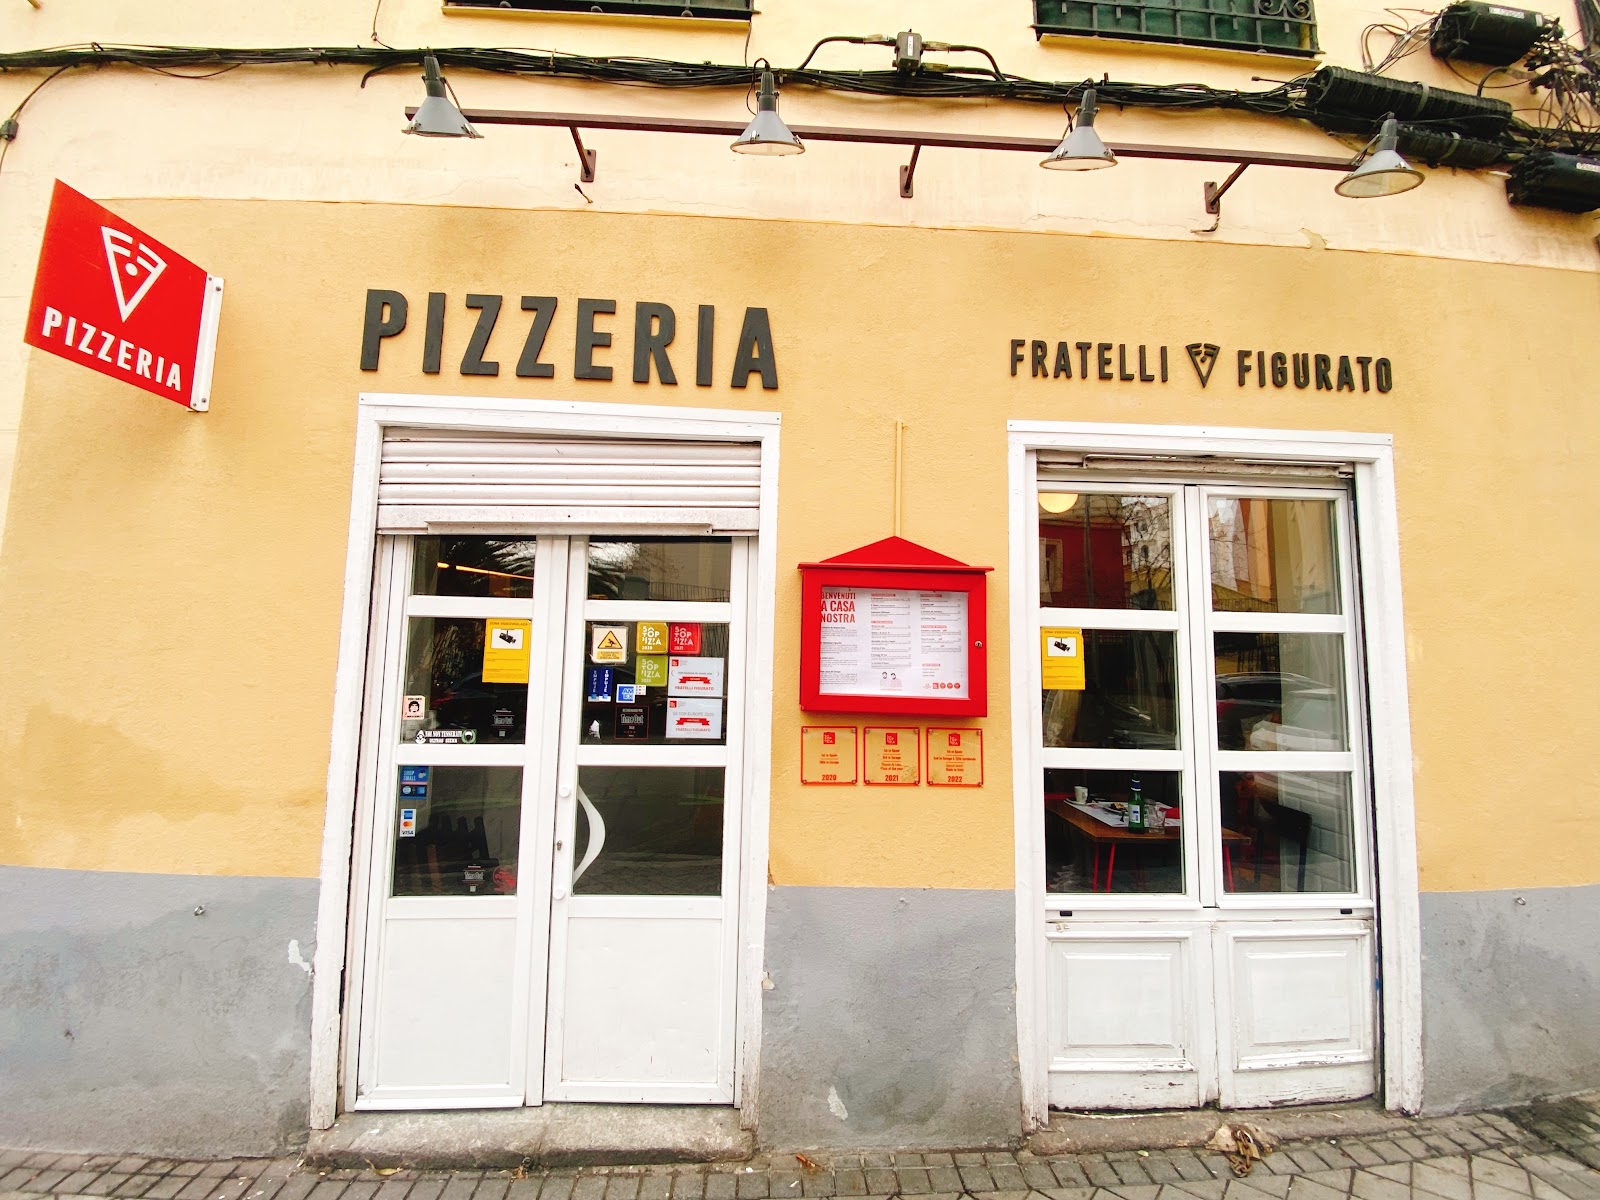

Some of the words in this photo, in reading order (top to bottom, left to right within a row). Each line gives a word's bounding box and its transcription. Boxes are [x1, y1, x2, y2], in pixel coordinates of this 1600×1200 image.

[360, 289, 778, 389] PIZZERIA
[42, 306, 181, 391] PIZZERIA
[1010, 338, 1168, 383] FRATELLI
[1237, 349, 1393, 393] FIGURATO
[821, 591, 856, 600] BENVENUTI
[830, 601, 856, 612] CASA
[821, 613, 856, 624] NOSTRA
[642, 630, 660, 638] TOP
[641, 663, 659, 671] TOP
[885, 774, 899, 782] 2021
[947, 775, 963, 783] 2022
